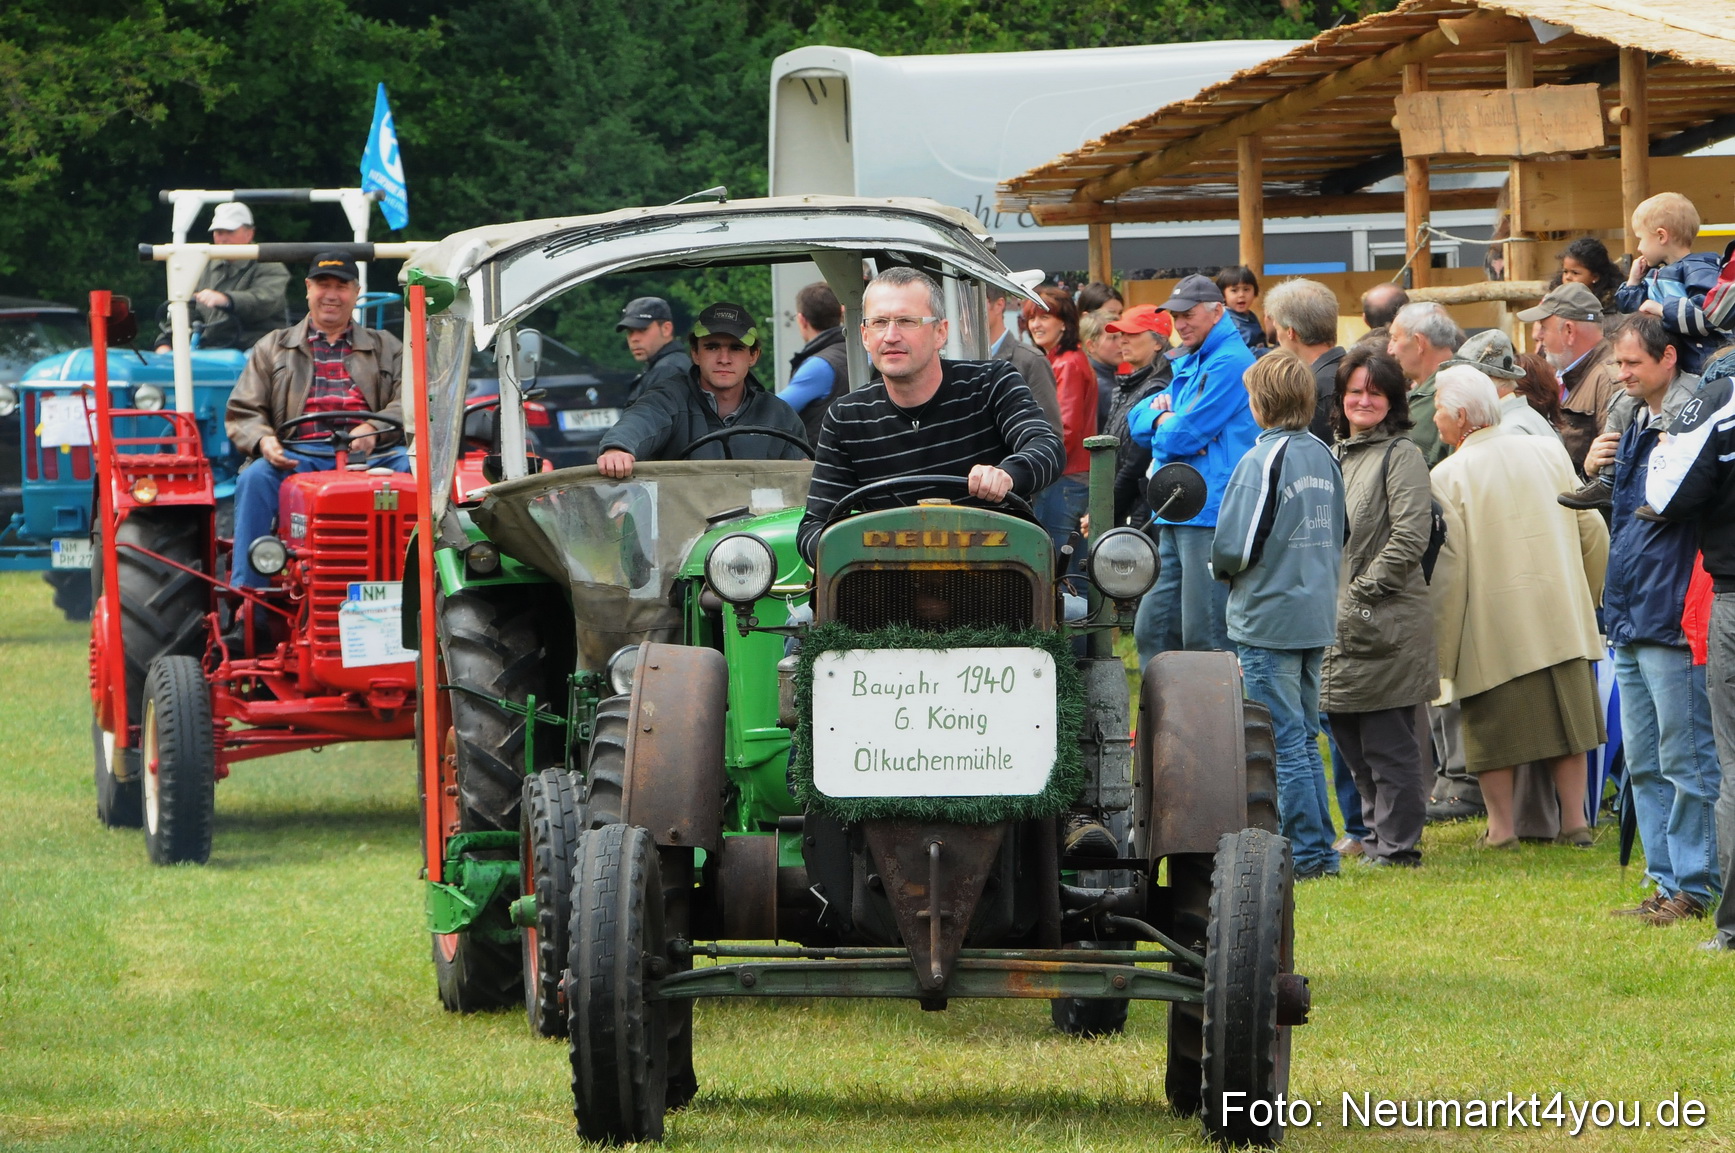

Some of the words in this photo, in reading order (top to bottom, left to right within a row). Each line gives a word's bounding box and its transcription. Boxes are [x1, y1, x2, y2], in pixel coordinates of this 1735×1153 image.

[61, 542, 77, 553] NM
[863, 530, 1009, 548] DEUTZ
[363, 585, 386, 601] NM
[852, 670, 940, 700] Baujahr
[957, 665, 1015, 694] 1940
[895, 706, 914, 731] G.
[928, 706, 988, 736] König
[854, 741, 1013, 772] Ölkuchenmühle
